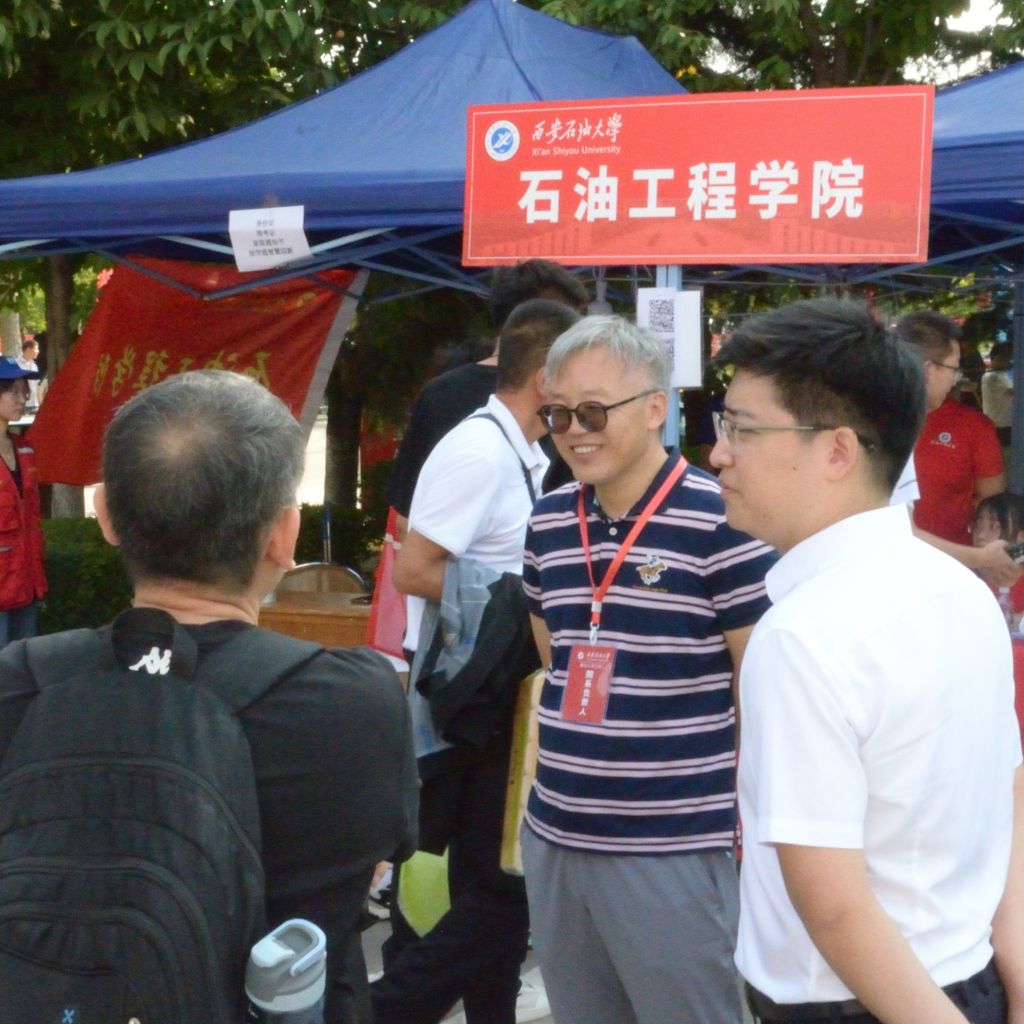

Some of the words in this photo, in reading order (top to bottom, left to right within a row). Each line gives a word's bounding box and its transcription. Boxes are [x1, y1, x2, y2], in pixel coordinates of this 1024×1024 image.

[531, 112, 622, 145] 西安石油大学
[532, 148, 551, 156] Xi'an
[553, 147, 579, 157] Shiyou
[582, 145, 621, 155] University
[518, 158, 864, 224] 石油工程学院
